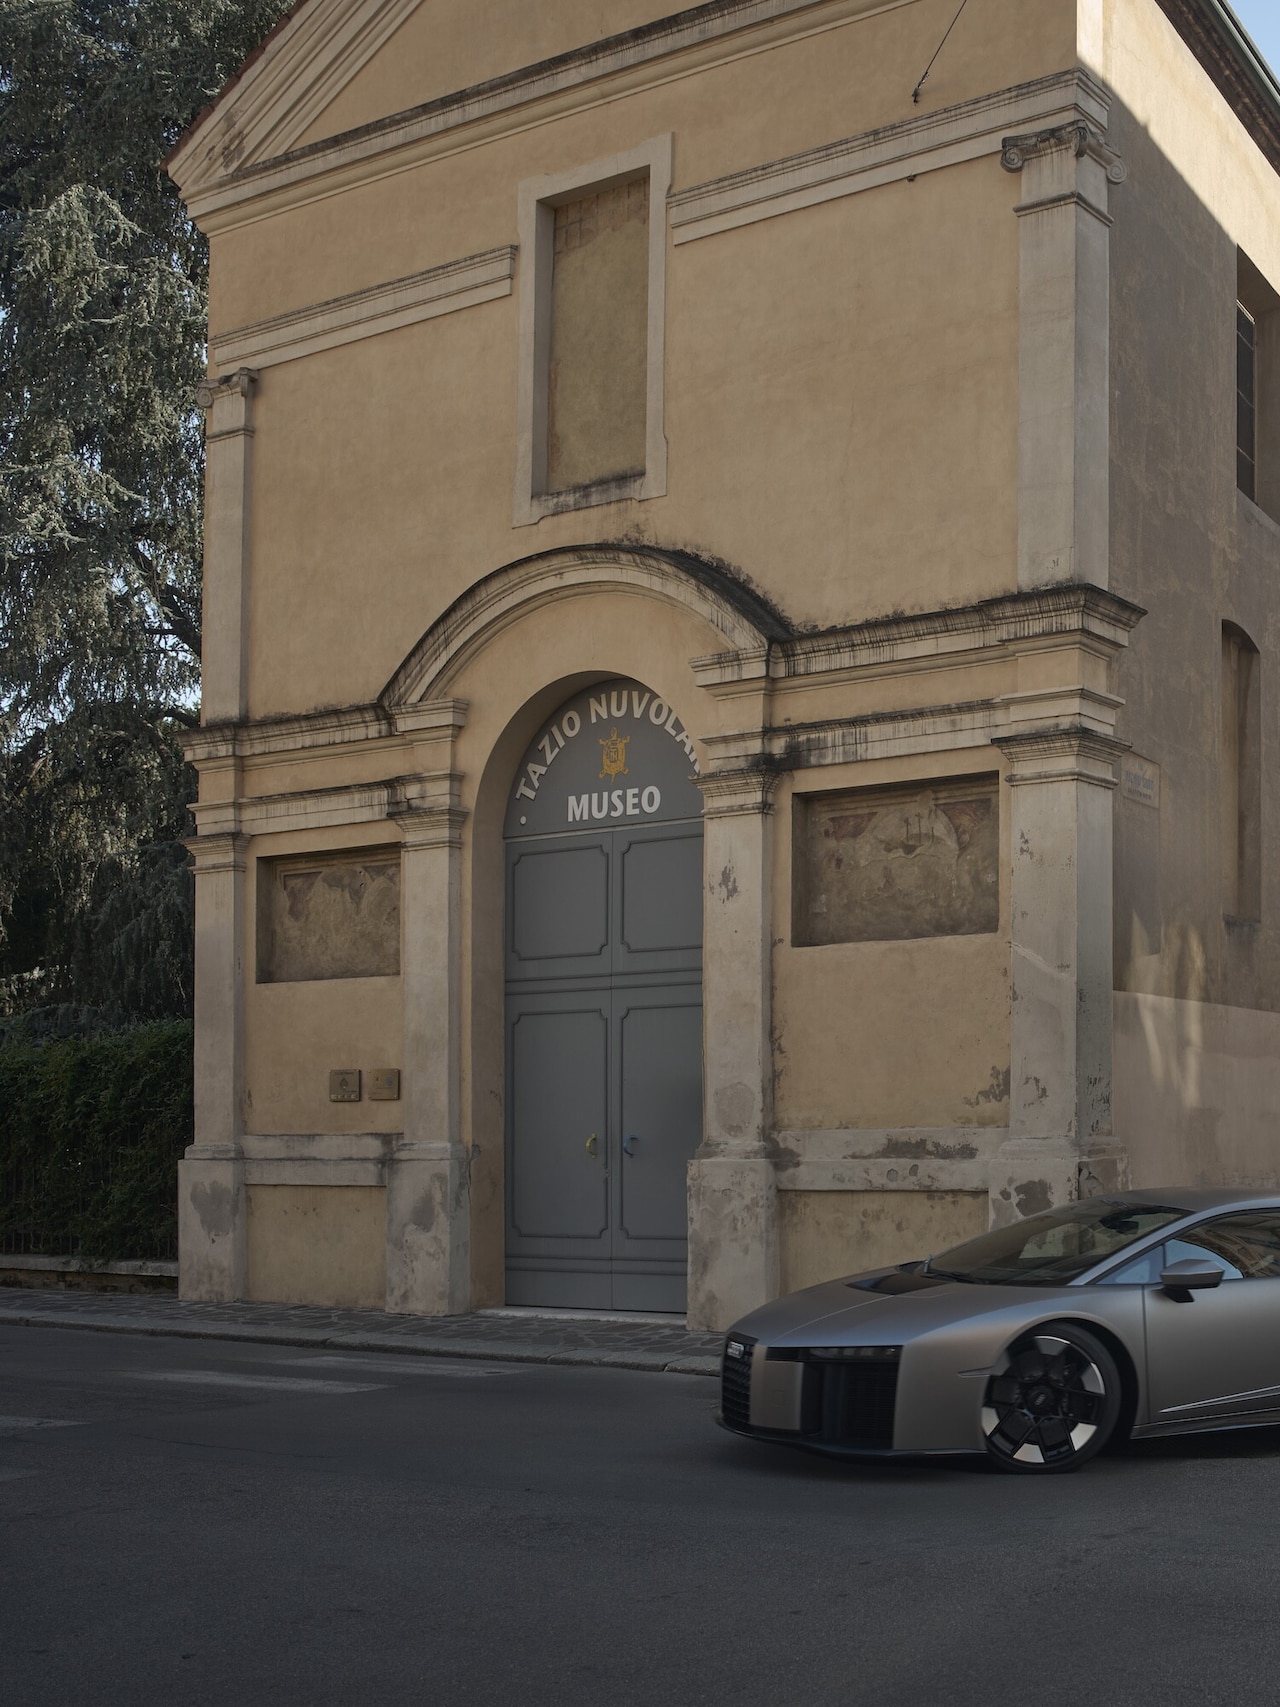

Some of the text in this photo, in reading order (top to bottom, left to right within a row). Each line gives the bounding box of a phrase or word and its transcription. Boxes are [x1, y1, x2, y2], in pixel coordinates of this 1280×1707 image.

[515, 690, 701, 801] TAZIO NUVOLA
[567, 785, 661, 823] MUSEO
